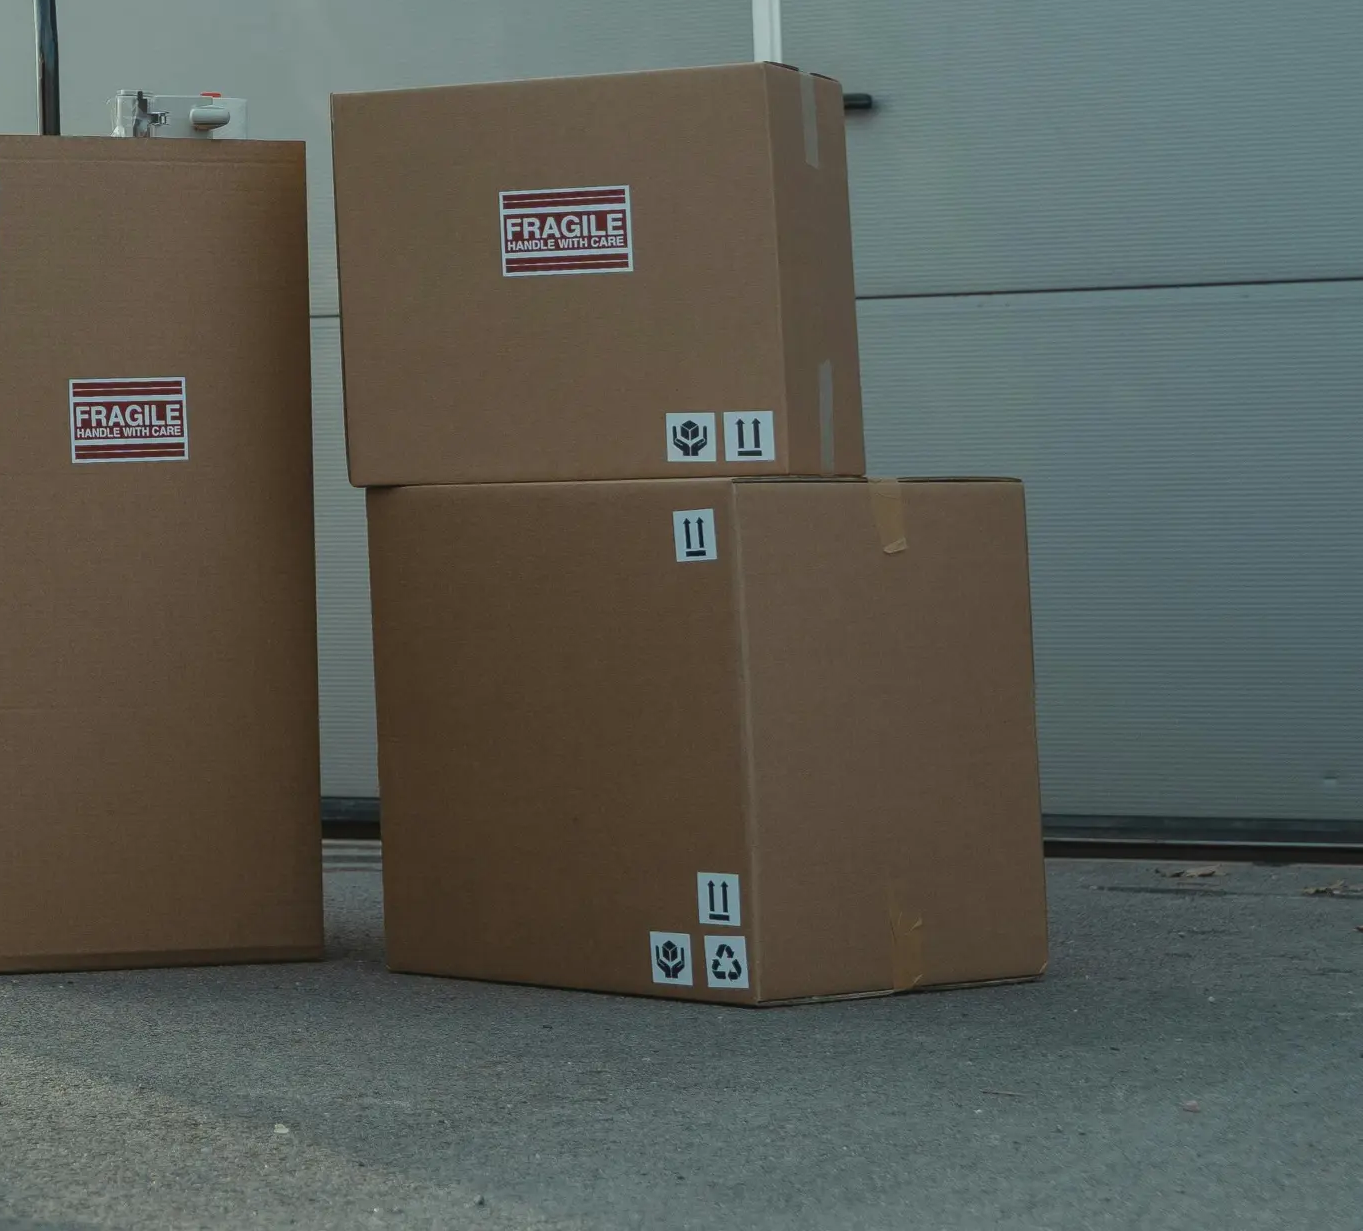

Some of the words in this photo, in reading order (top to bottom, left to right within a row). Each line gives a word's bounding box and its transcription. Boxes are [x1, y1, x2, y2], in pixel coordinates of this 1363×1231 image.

[506, 213, 624, 240] FRAGILE
[507, 239, 555, 251] HANDLE
[558, 238, 588, 248] WITH
[590, 236, 624, 247] CARE
[75, 404, 181, 427] FRAGILE
[77, 427, 120, 438] HANDLE
[122, 426, 149, 437] WITH
[151, 426, 181, 436] CARE
